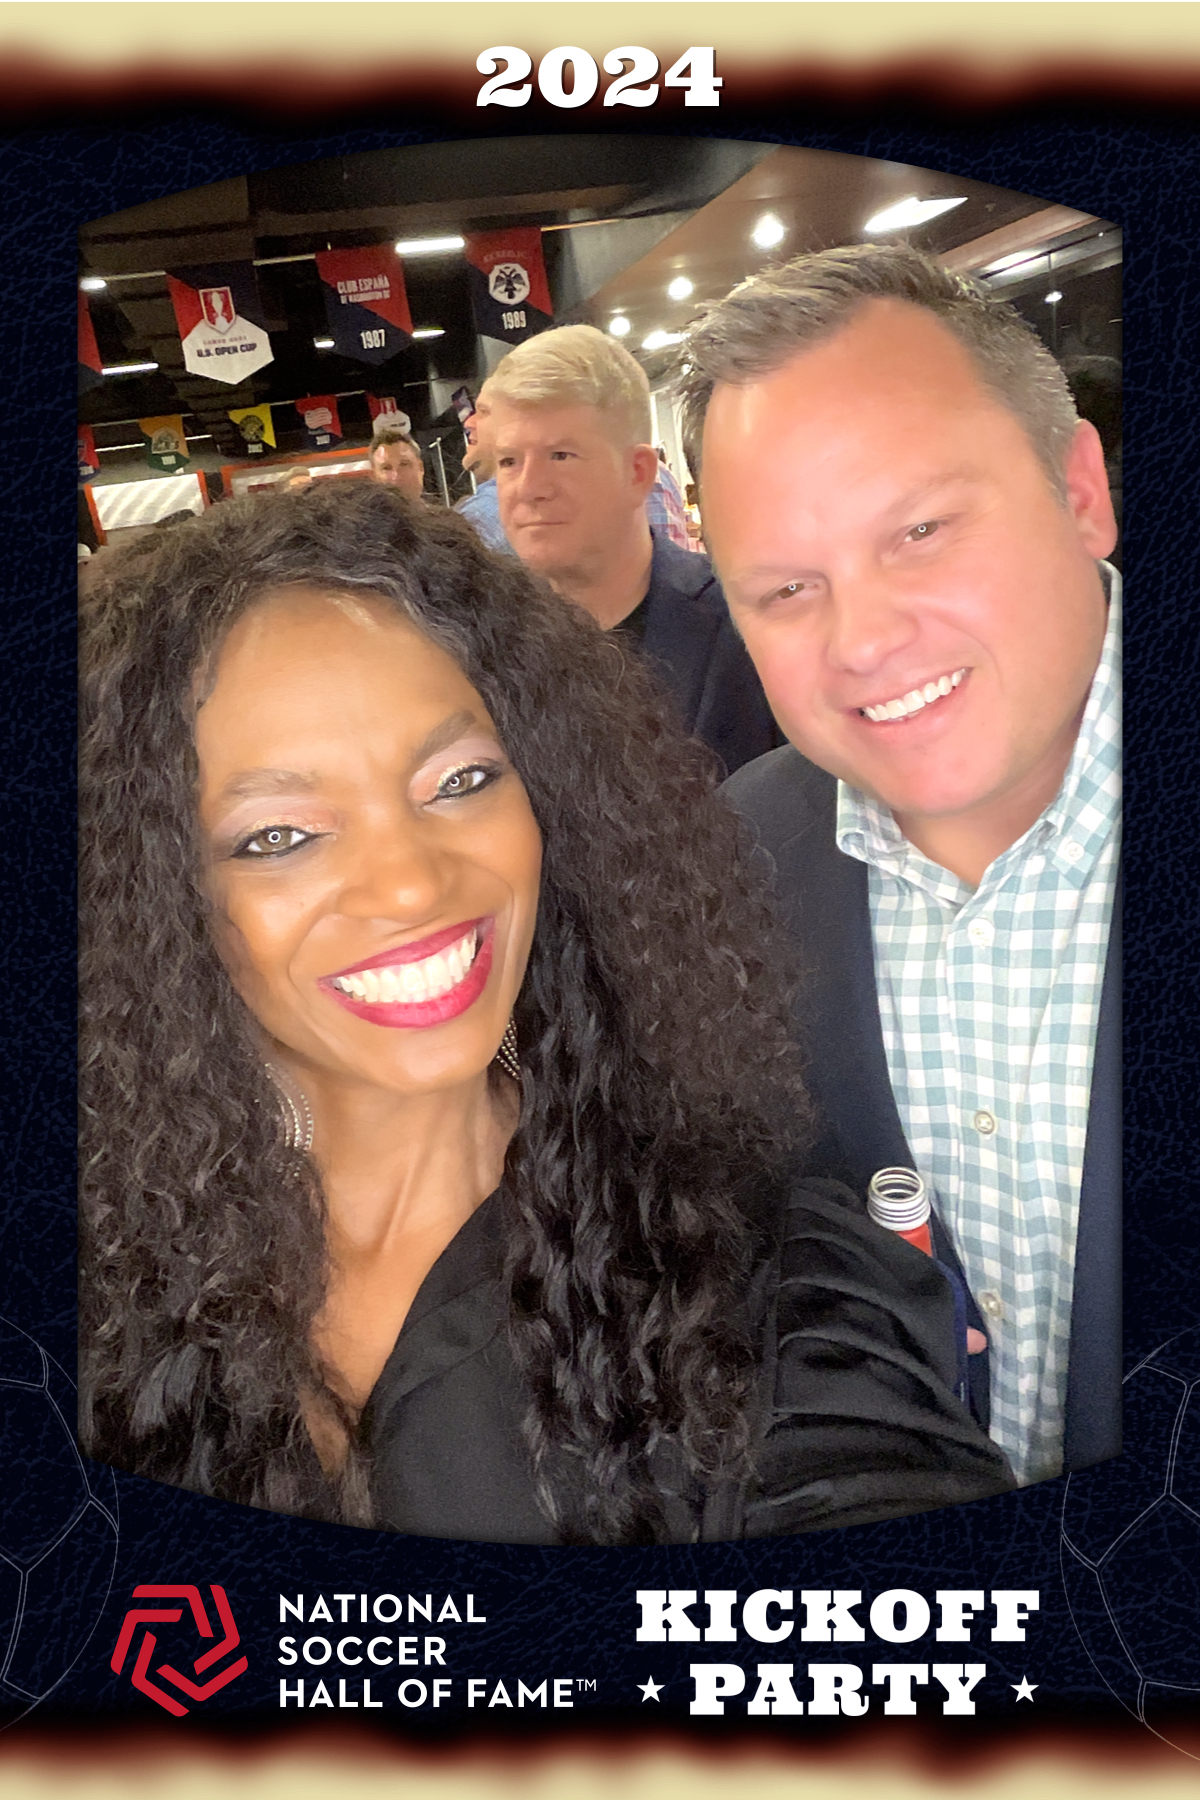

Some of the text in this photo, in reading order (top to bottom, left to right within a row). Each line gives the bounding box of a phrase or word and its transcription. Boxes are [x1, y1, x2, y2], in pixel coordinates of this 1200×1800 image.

[337, 274, 390, 294] CLUB ESPAÑA
[502, 310, 527, 330] 1989
[360, 328, 386, 349] 1987
[215, 345, 239, 356] OPEN
[240, 342, 257, 353] CUP
